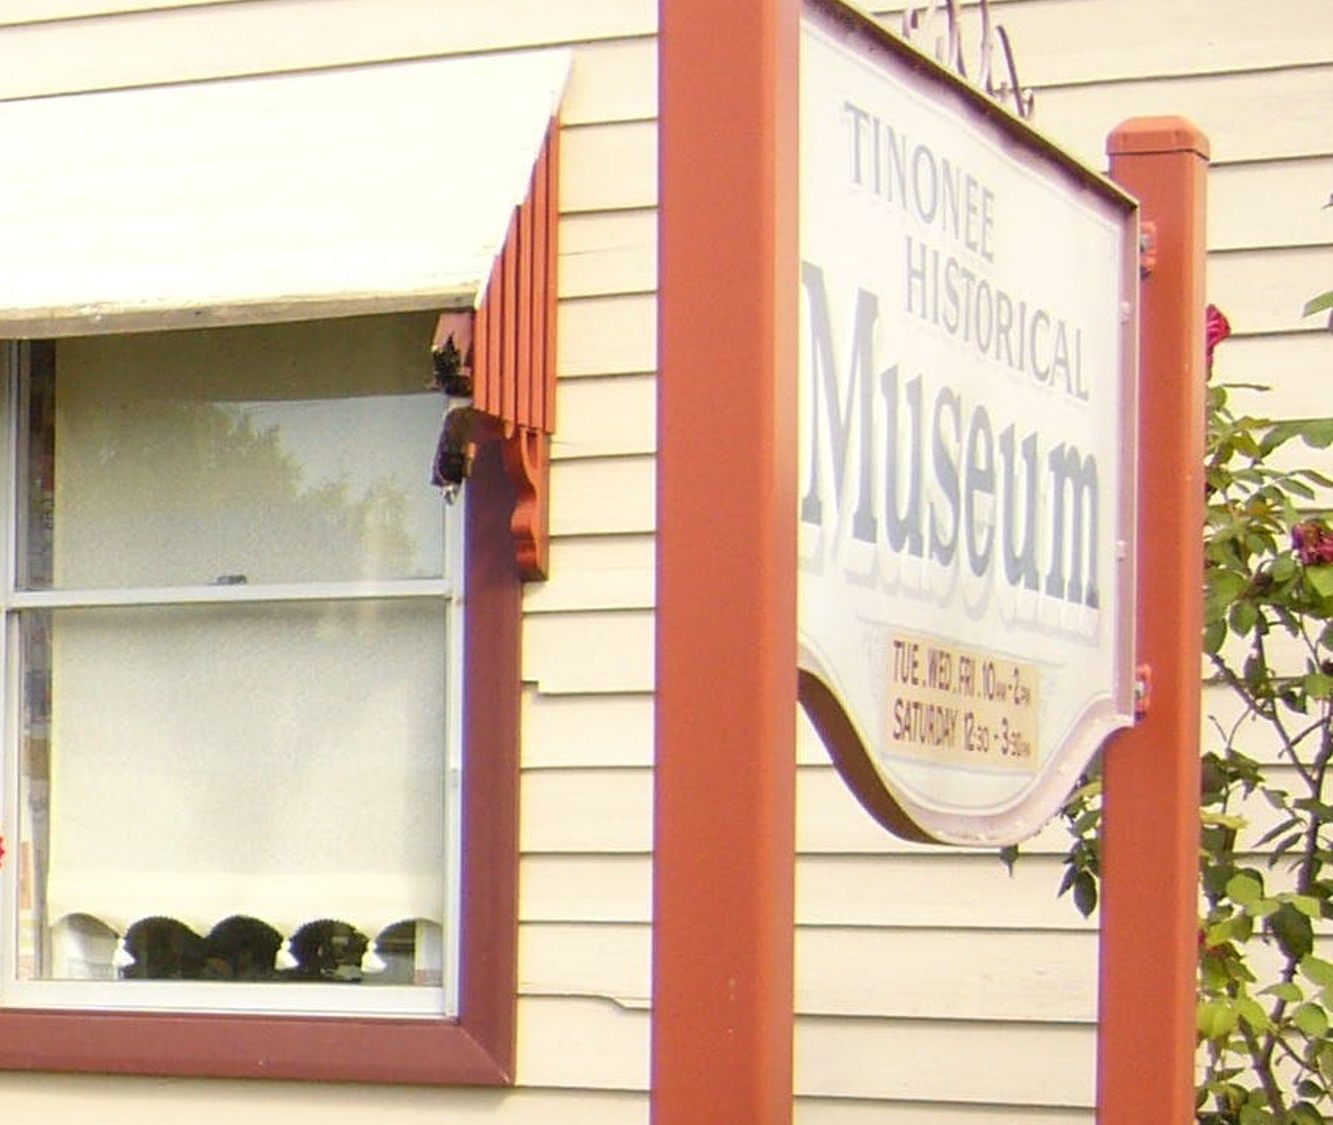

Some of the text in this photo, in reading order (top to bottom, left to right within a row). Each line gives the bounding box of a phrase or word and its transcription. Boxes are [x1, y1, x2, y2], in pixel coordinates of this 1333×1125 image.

[844, 101, 994, 264] TINONEE
[905, 236, 1090, 402] HISTORICAL
[800, 260, 1101, 610] Museum
[893, 698, 958, 747] SATURDAY
